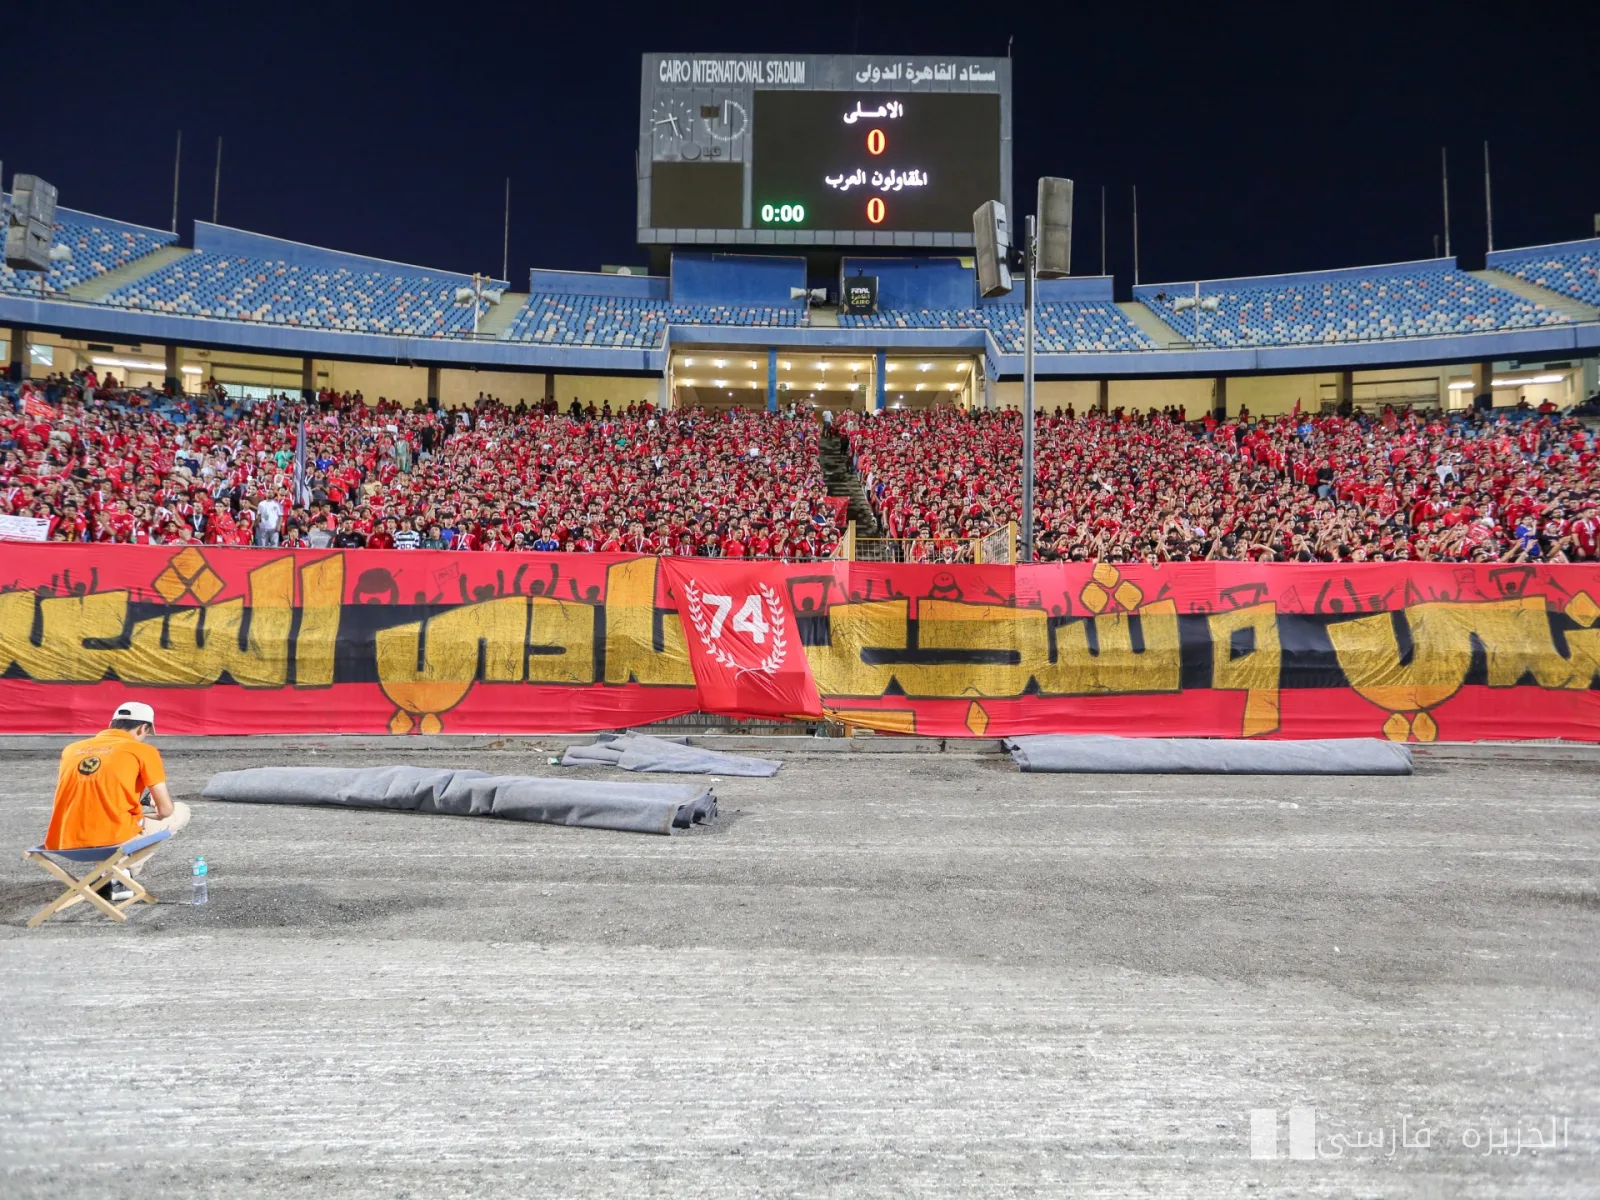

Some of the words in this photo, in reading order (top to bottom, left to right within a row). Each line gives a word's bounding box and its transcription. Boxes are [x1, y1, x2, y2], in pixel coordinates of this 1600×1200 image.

[659, 60, 691, 82] CAIRO
[692, 60, 765, 83] INTERNATIONAL
[766, 61, 806, 84] STADIUM
[905, 62, 956, 84] القاهرة
[959, 64, 997, 81] ستاد
[867, 129, 886, 155] 0
[825, 169, 867, 189] العرب
[870, 169, 929, 191] المقاولون
[761, 204, 805, 222] 0:00
[867, 198, 886, 224] 0
[702, 593, 770, 644] 74
